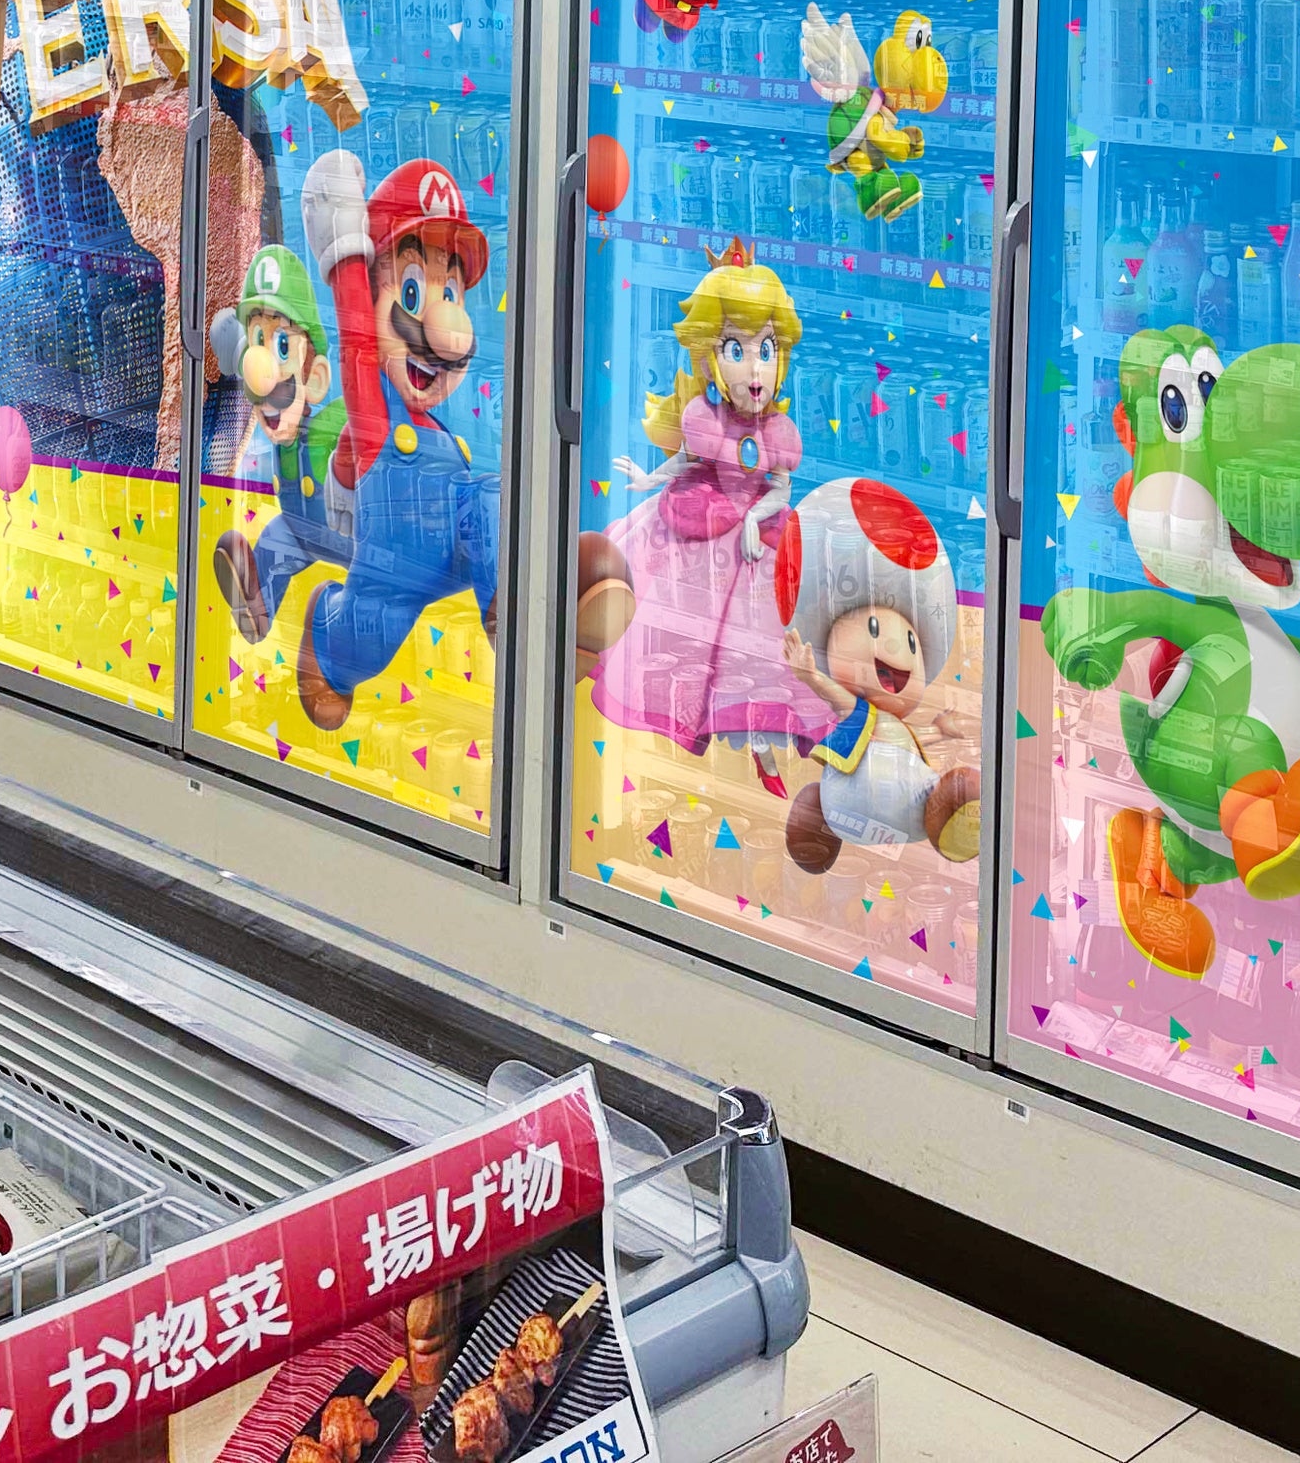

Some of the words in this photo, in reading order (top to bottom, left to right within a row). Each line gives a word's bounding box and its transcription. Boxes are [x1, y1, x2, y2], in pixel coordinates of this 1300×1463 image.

[590, 65, 626, 84] 新発売
[644, 71, 682, 90] 新発売
[759, 82, 800, 101] 新発売
[820, 86, 862, 106] 新発売
[884, 91, 928, 111] 新発売
[950, 96, 994, 117] 新発売
[423, 175, 457, 218] M
[589, 217, 623, 237] 新発売
[641, 225, 678, 244] 新発売
[756, 241, 796, 261] 新発売
[817, 249, 859, 269] 新発売
[260, 262, 273, 290] L
[880, 257, 923, 279] 新発売
[946, 266, 990, 289] 新発売
[49, 1138, 565, 1440] お惣菜・揚げ物
